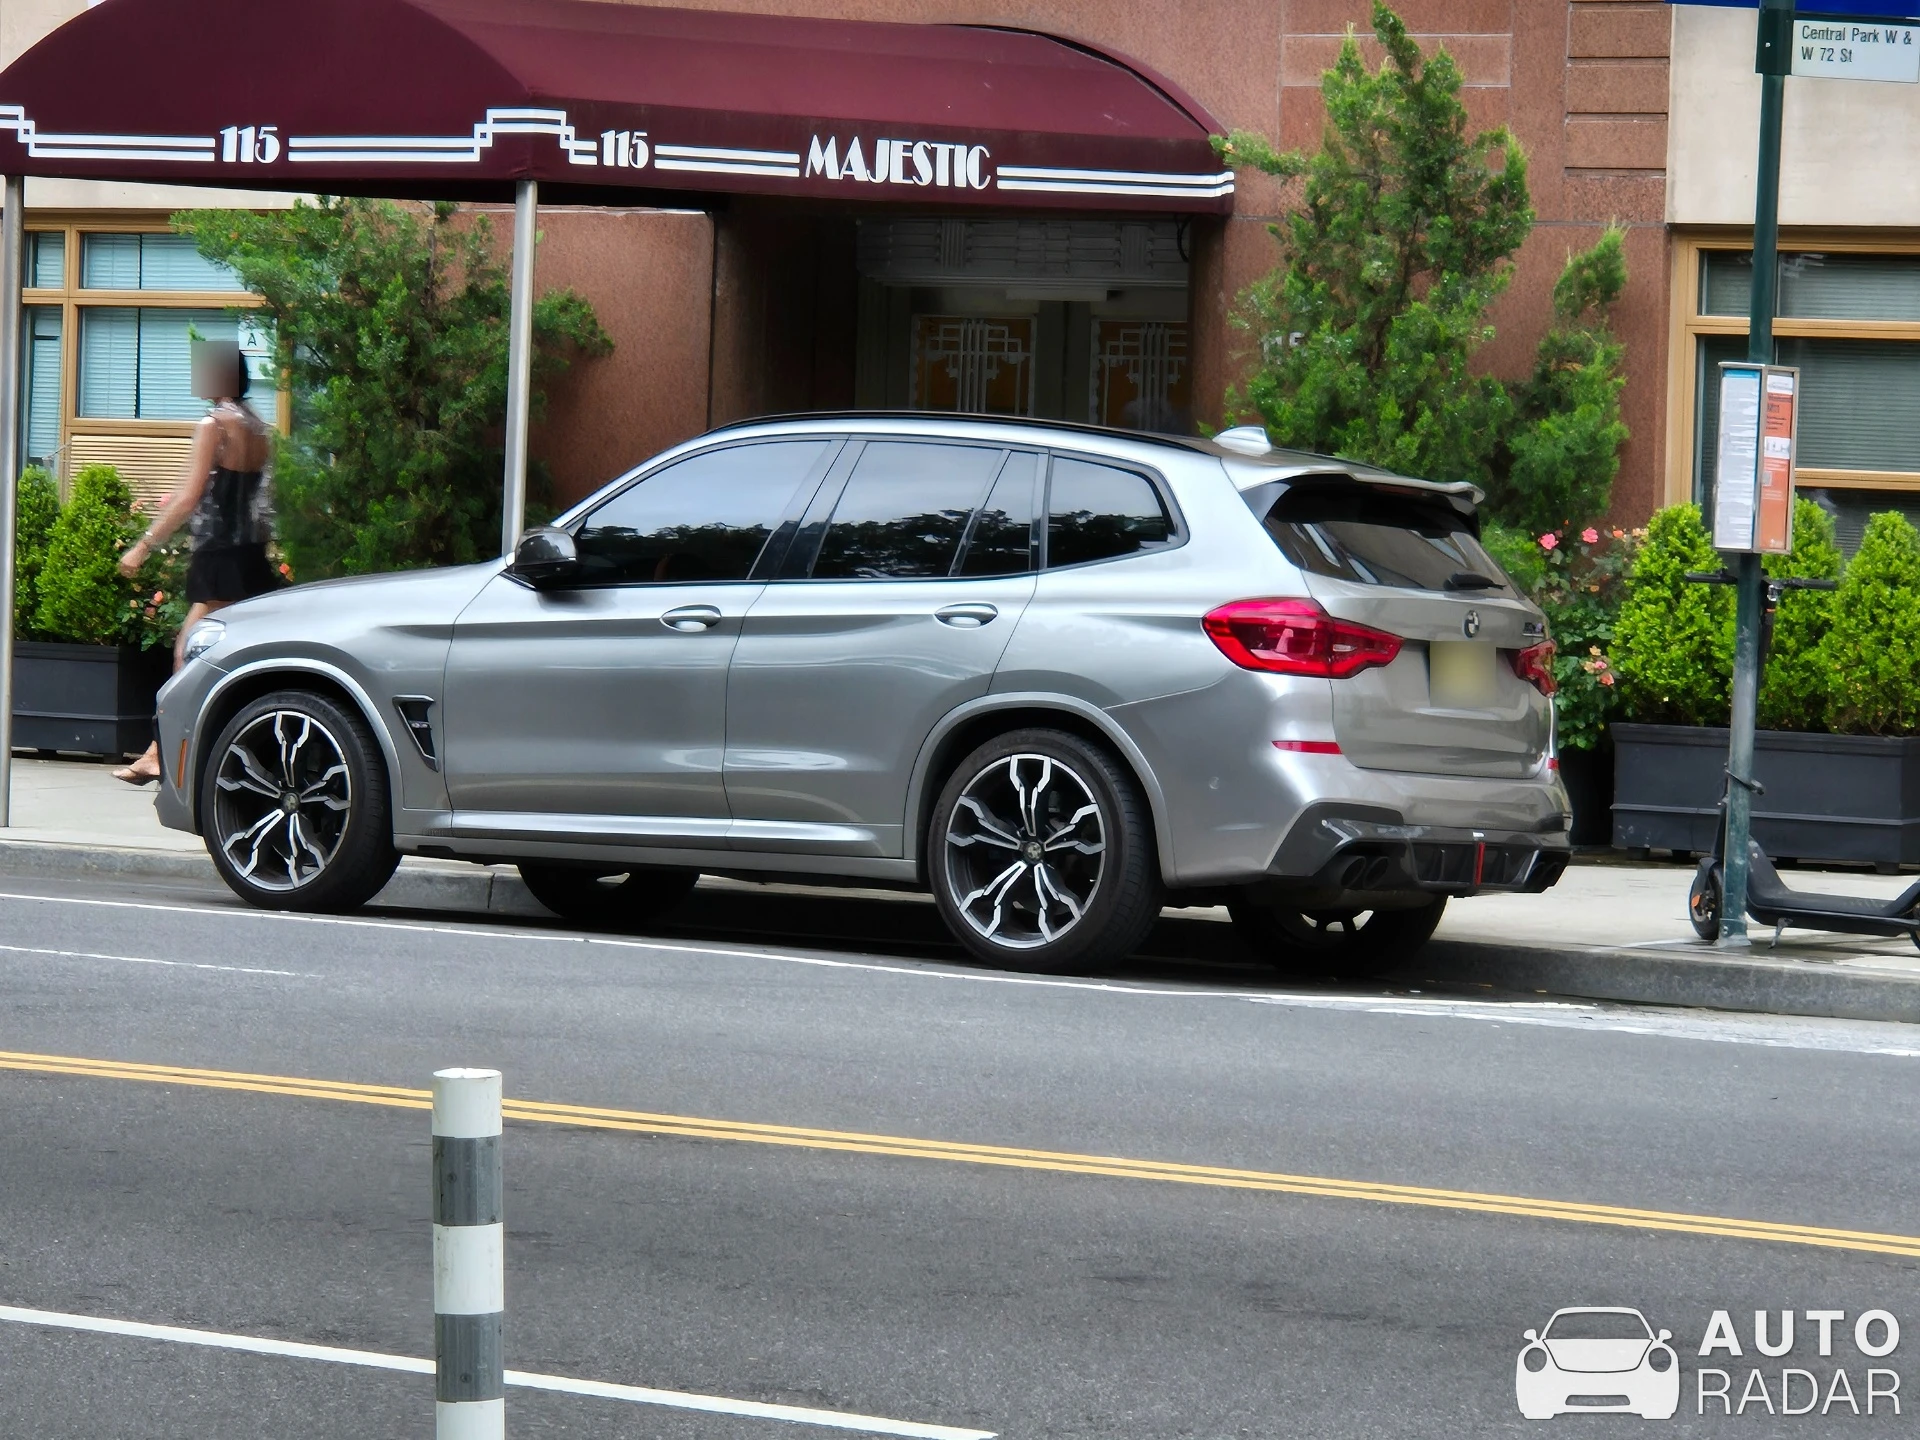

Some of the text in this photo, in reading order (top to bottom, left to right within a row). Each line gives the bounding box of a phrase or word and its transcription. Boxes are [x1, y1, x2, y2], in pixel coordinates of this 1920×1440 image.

[1802, 25, 1912, 45] Central Park W &
[1802, 46, 1852, 62] W 72 St
[220, 126, 280, 163] 115
[601, 130, 991, 190] 115 MAJESTIC
